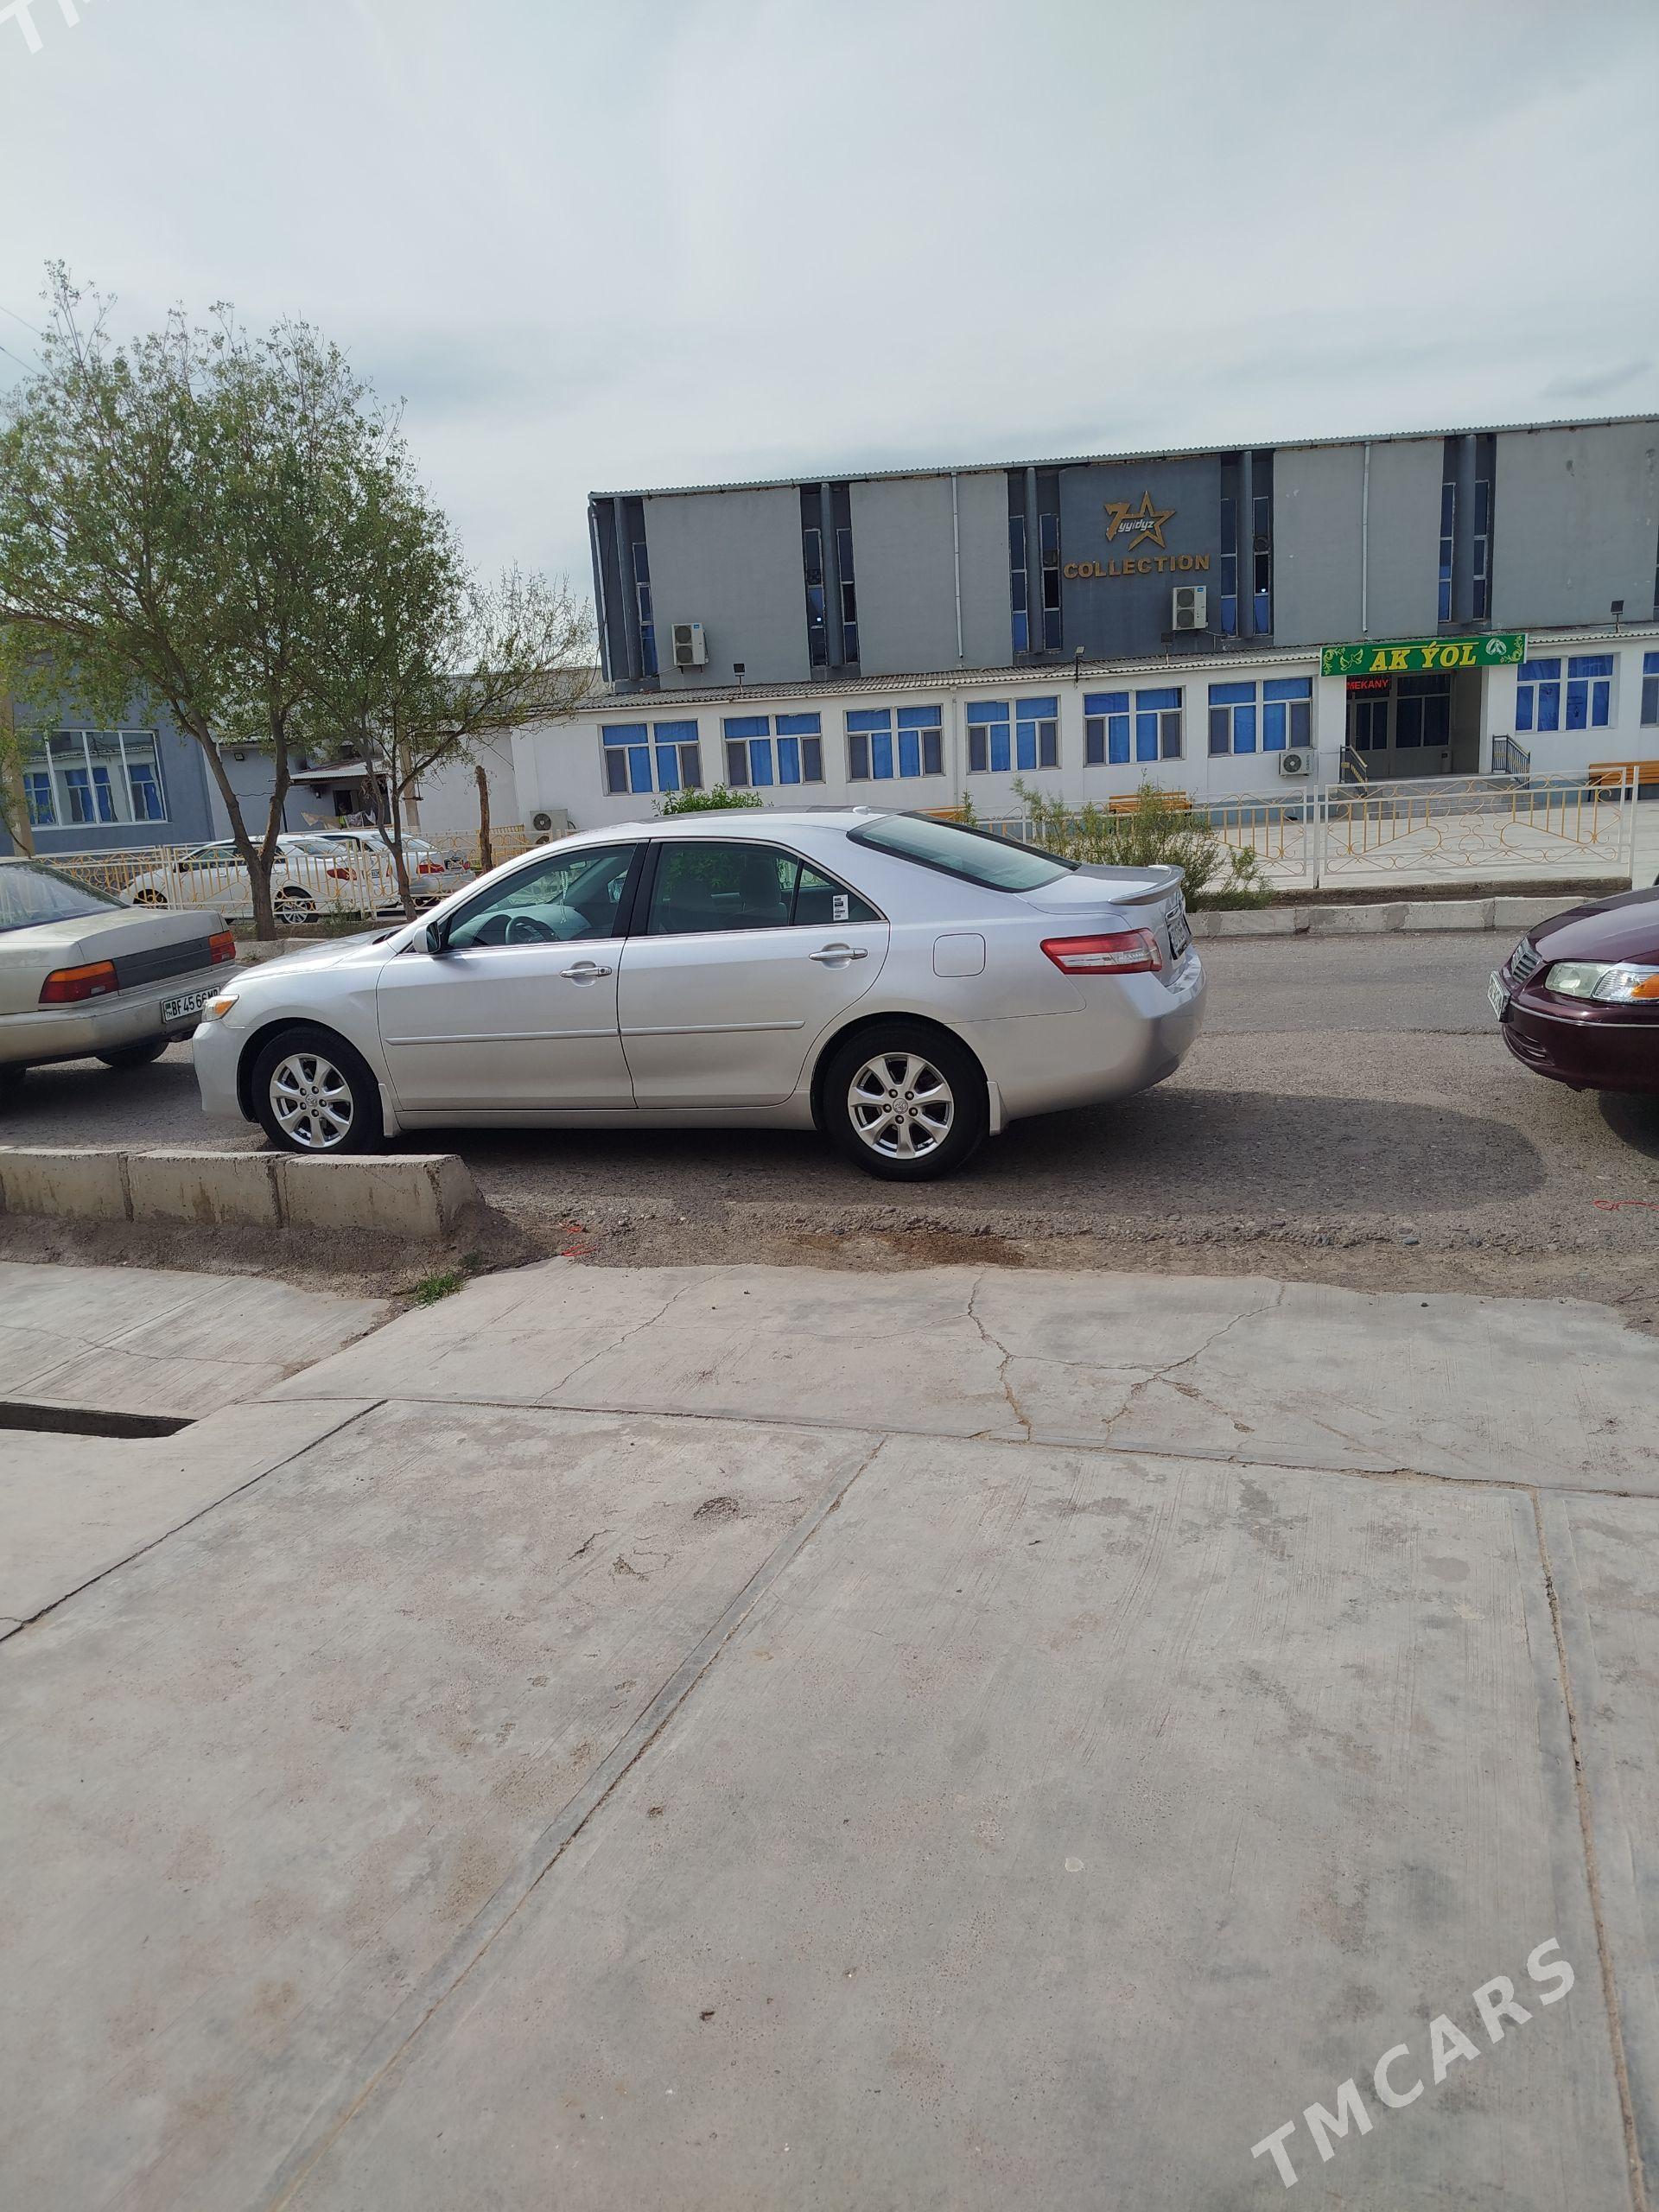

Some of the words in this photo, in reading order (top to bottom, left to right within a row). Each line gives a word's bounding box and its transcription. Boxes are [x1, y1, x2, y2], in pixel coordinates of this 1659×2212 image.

[1064, 554, 1211, 579] COLLECTION
[1369, 649, 1411, 672] AK
[1421, 641, 1478, 669] ÝOL
